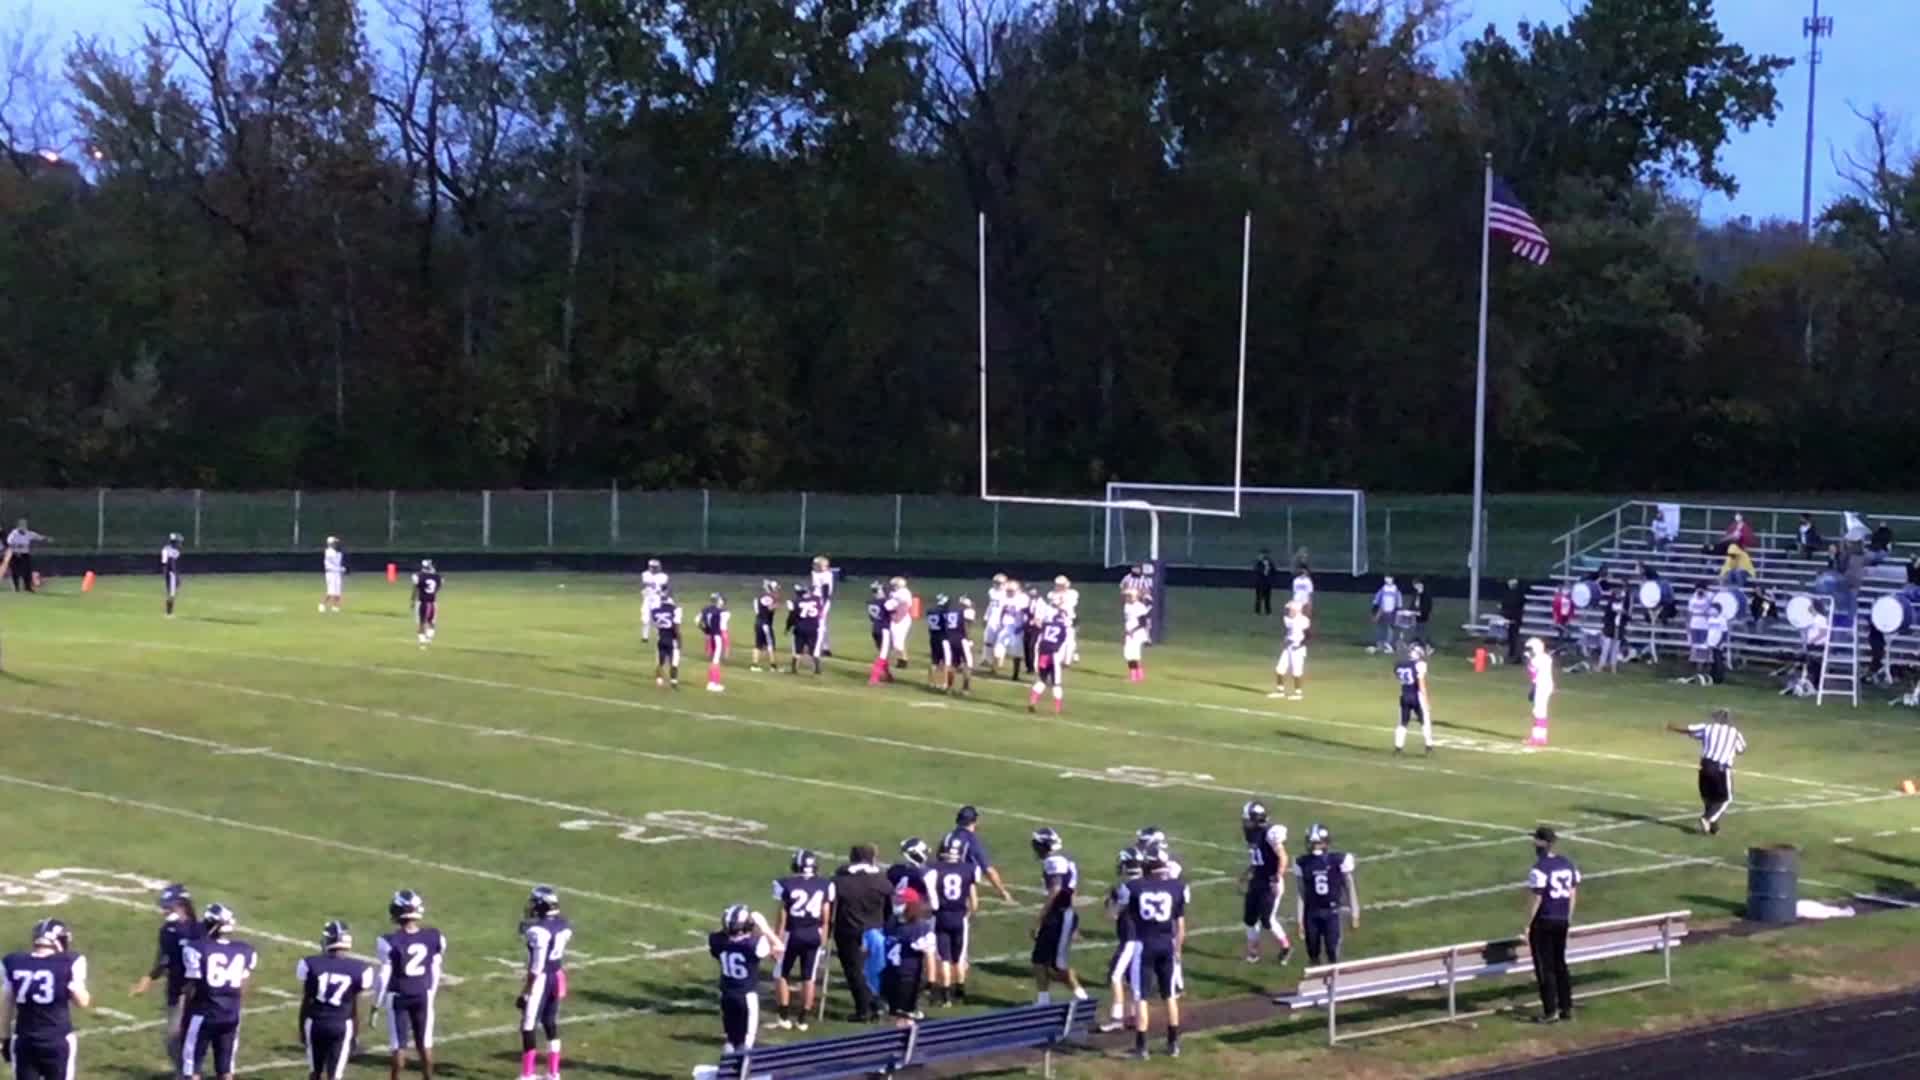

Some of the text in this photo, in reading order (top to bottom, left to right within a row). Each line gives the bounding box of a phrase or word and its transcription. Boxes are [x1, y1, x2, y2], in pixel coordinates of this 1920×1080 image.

[1043, 625, 1061, 643] 12
[942, 873, 963, 901] 8
[1314, 874, 1329, 895] 6
[1549, 869, 1572, 899] 53
[789, 889, 824, 918] 24
[1139, 891, 1173, 922] 63
[206, 952, 246, 988] 64
[405, 942, 428, 977] 2
[719, 950, 748, 980] 16
[12, 969, 55, 1005] 73
[317, 971, 352, 1007] 17
